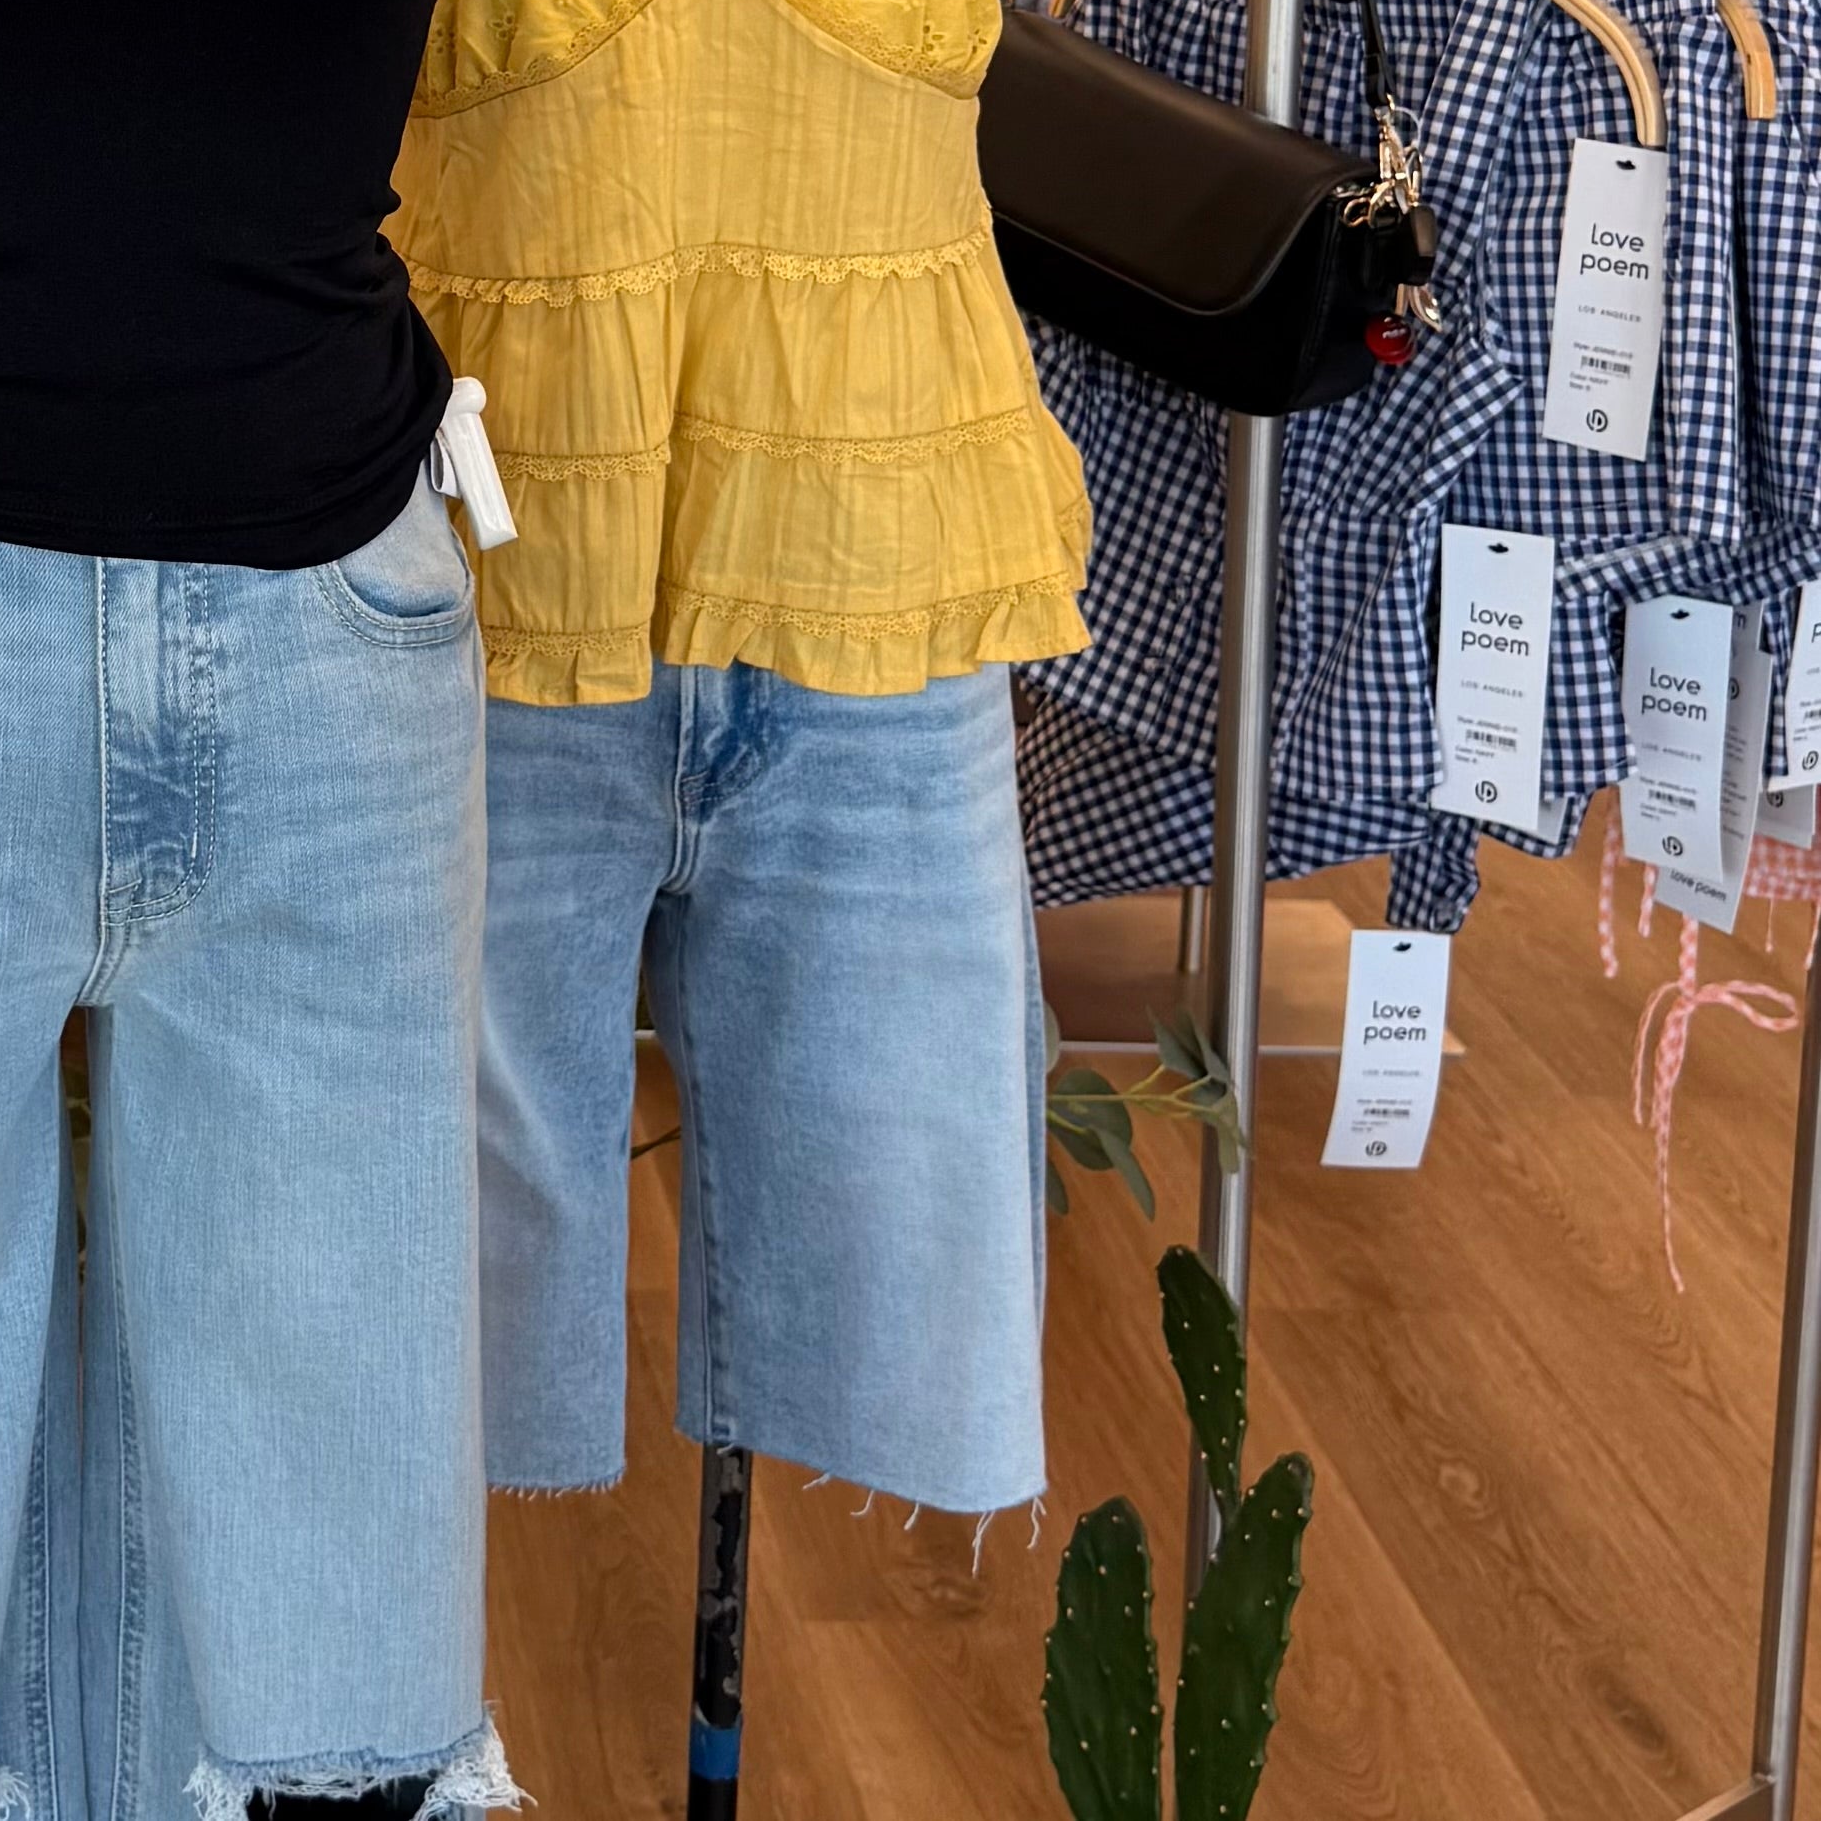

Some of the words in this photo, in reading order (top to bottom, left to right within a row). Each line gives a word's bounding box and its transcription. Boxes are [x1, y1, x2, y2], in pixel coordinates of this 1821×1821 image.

[1579, 253, 1649, 281] poem
[1460, 630, 1529, 657] poem
[1640, 694, 1707, 723] poem
[1362, 1025, 1428, 1046] poem
